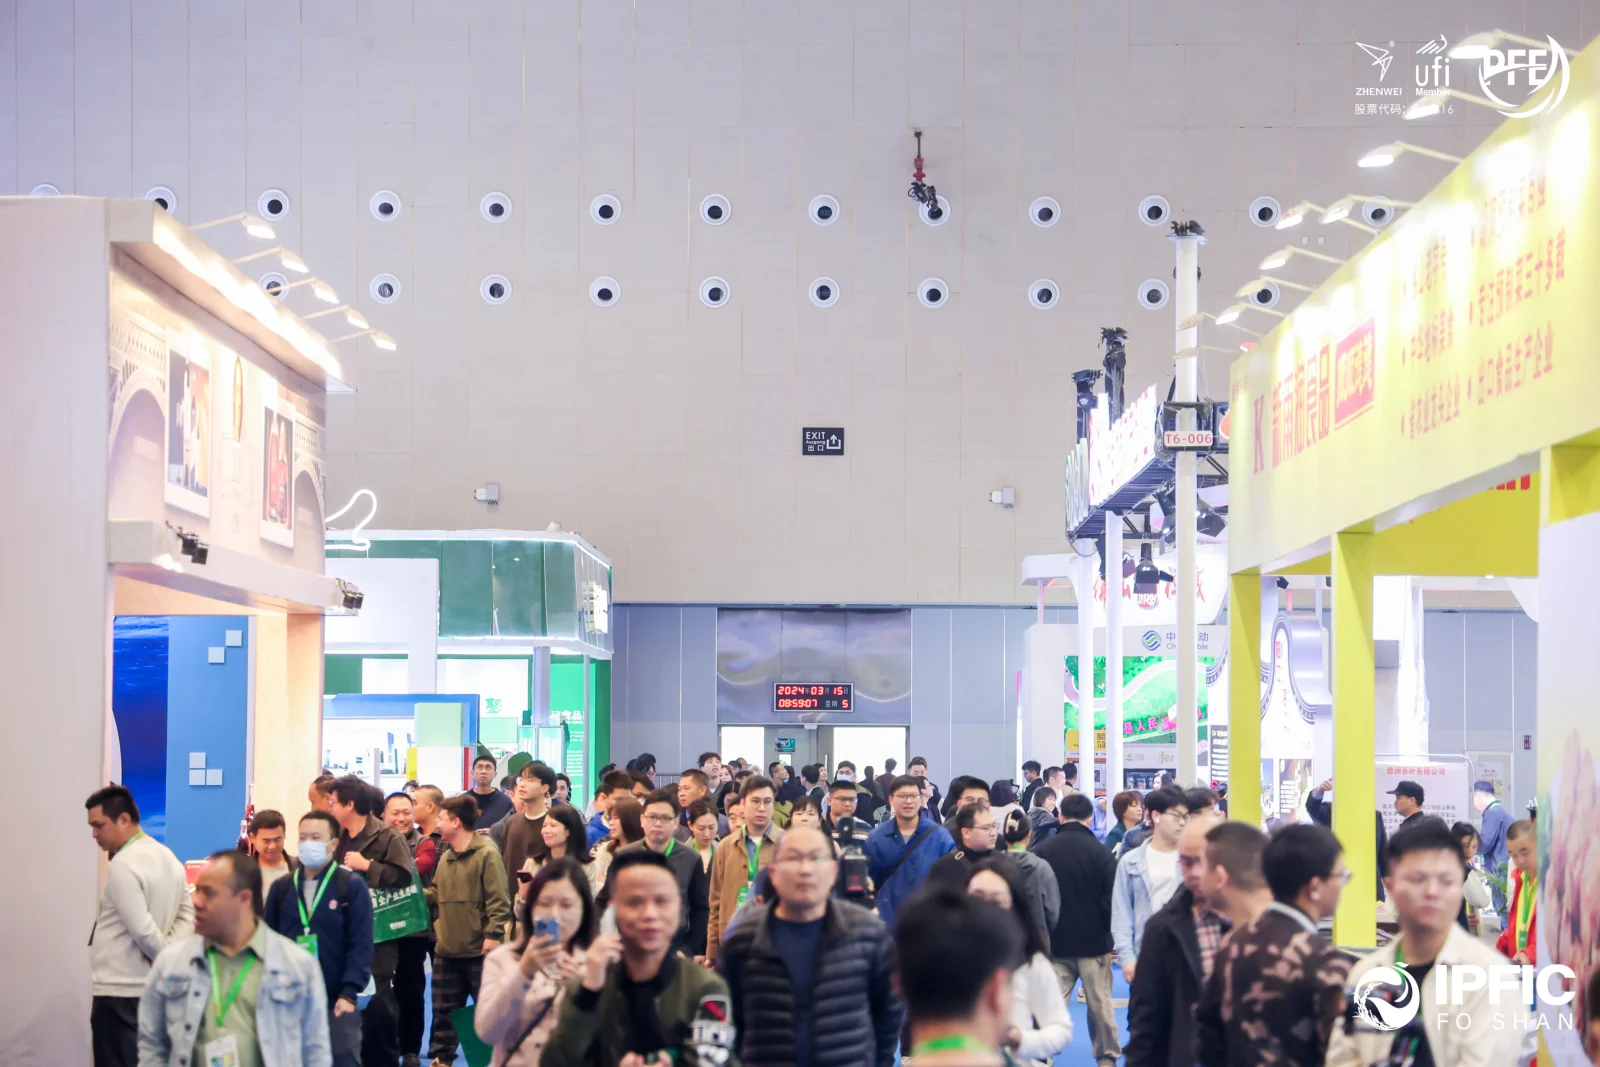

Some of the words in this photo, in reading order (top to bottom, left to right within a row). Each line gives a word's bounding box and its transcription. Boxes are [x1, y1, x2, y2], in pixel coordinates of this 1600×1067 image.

[806, 432, 826, 440] EXIT
[1165, 433, 1213, 444] T6-006
[1166, 632, 1209, 643] 中动
[778, 698, 818, 708] 08:59:07
[1123, 717, 1159, 735] 是人民
